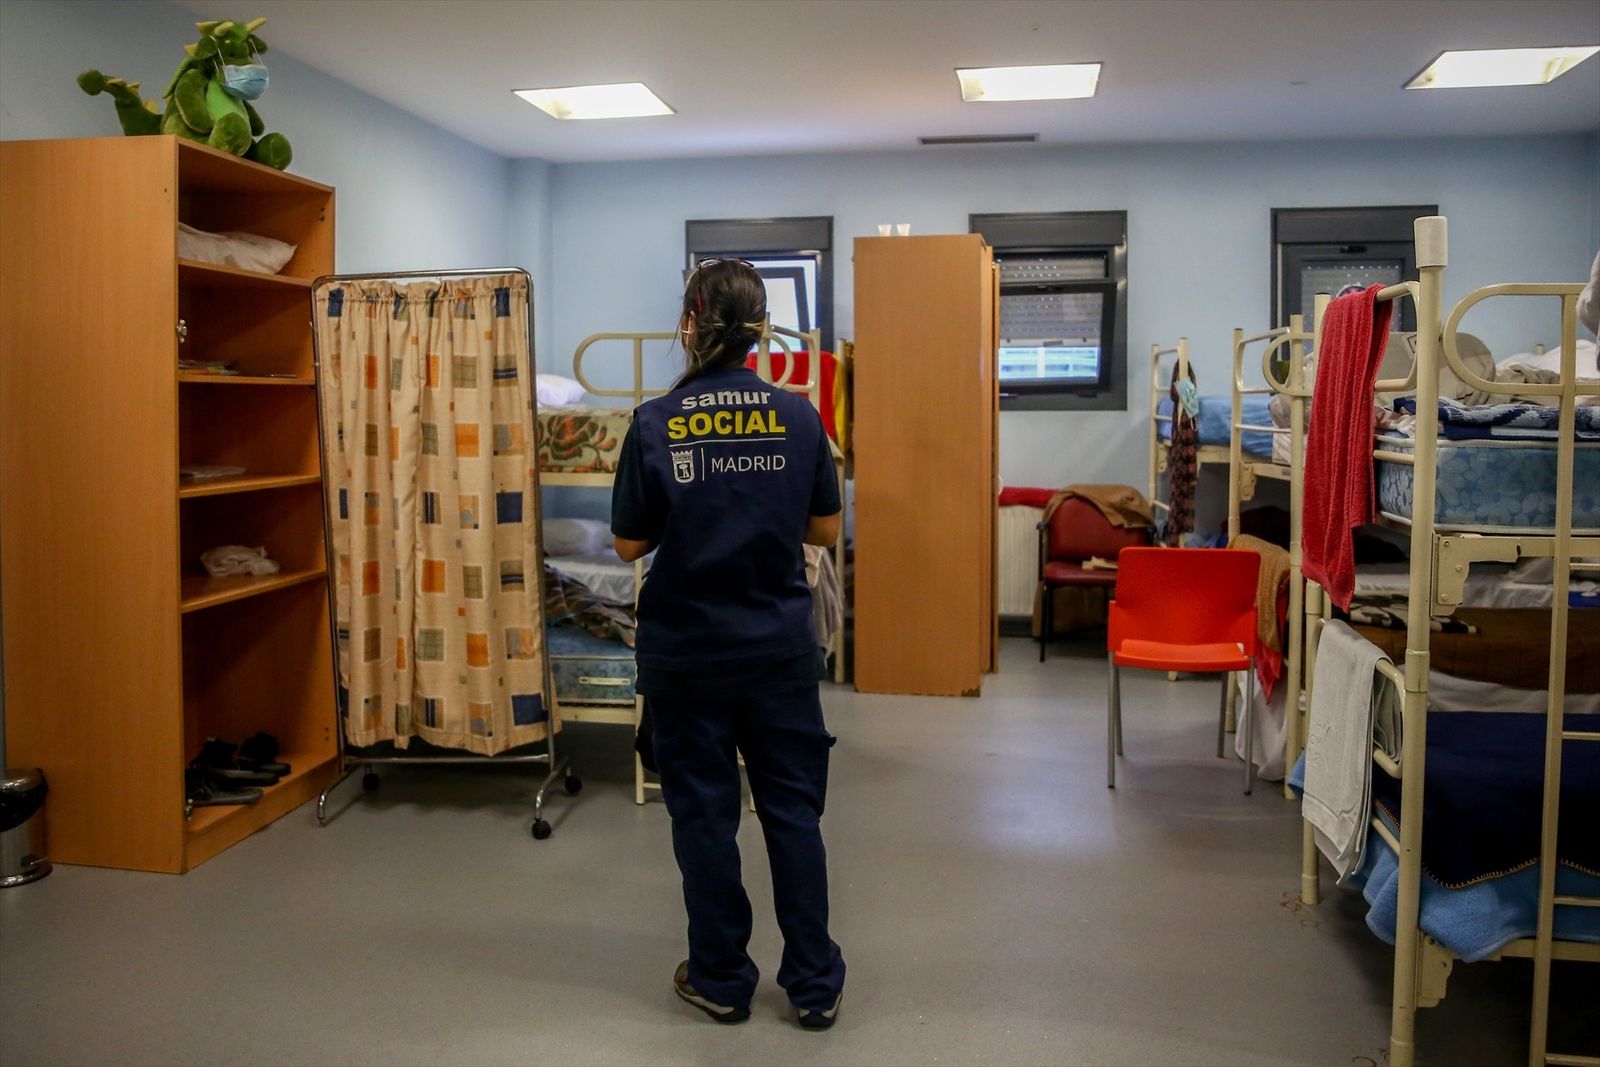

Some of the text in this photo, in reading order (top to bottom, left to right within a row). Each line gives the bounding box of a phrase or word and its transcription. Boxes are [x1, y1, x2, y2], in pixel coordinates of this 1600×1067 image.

[682, 391, 770, 410] samur
[667, 410, 786, 439] SOCIAL
[711, 455, 786, 472] MADRID
